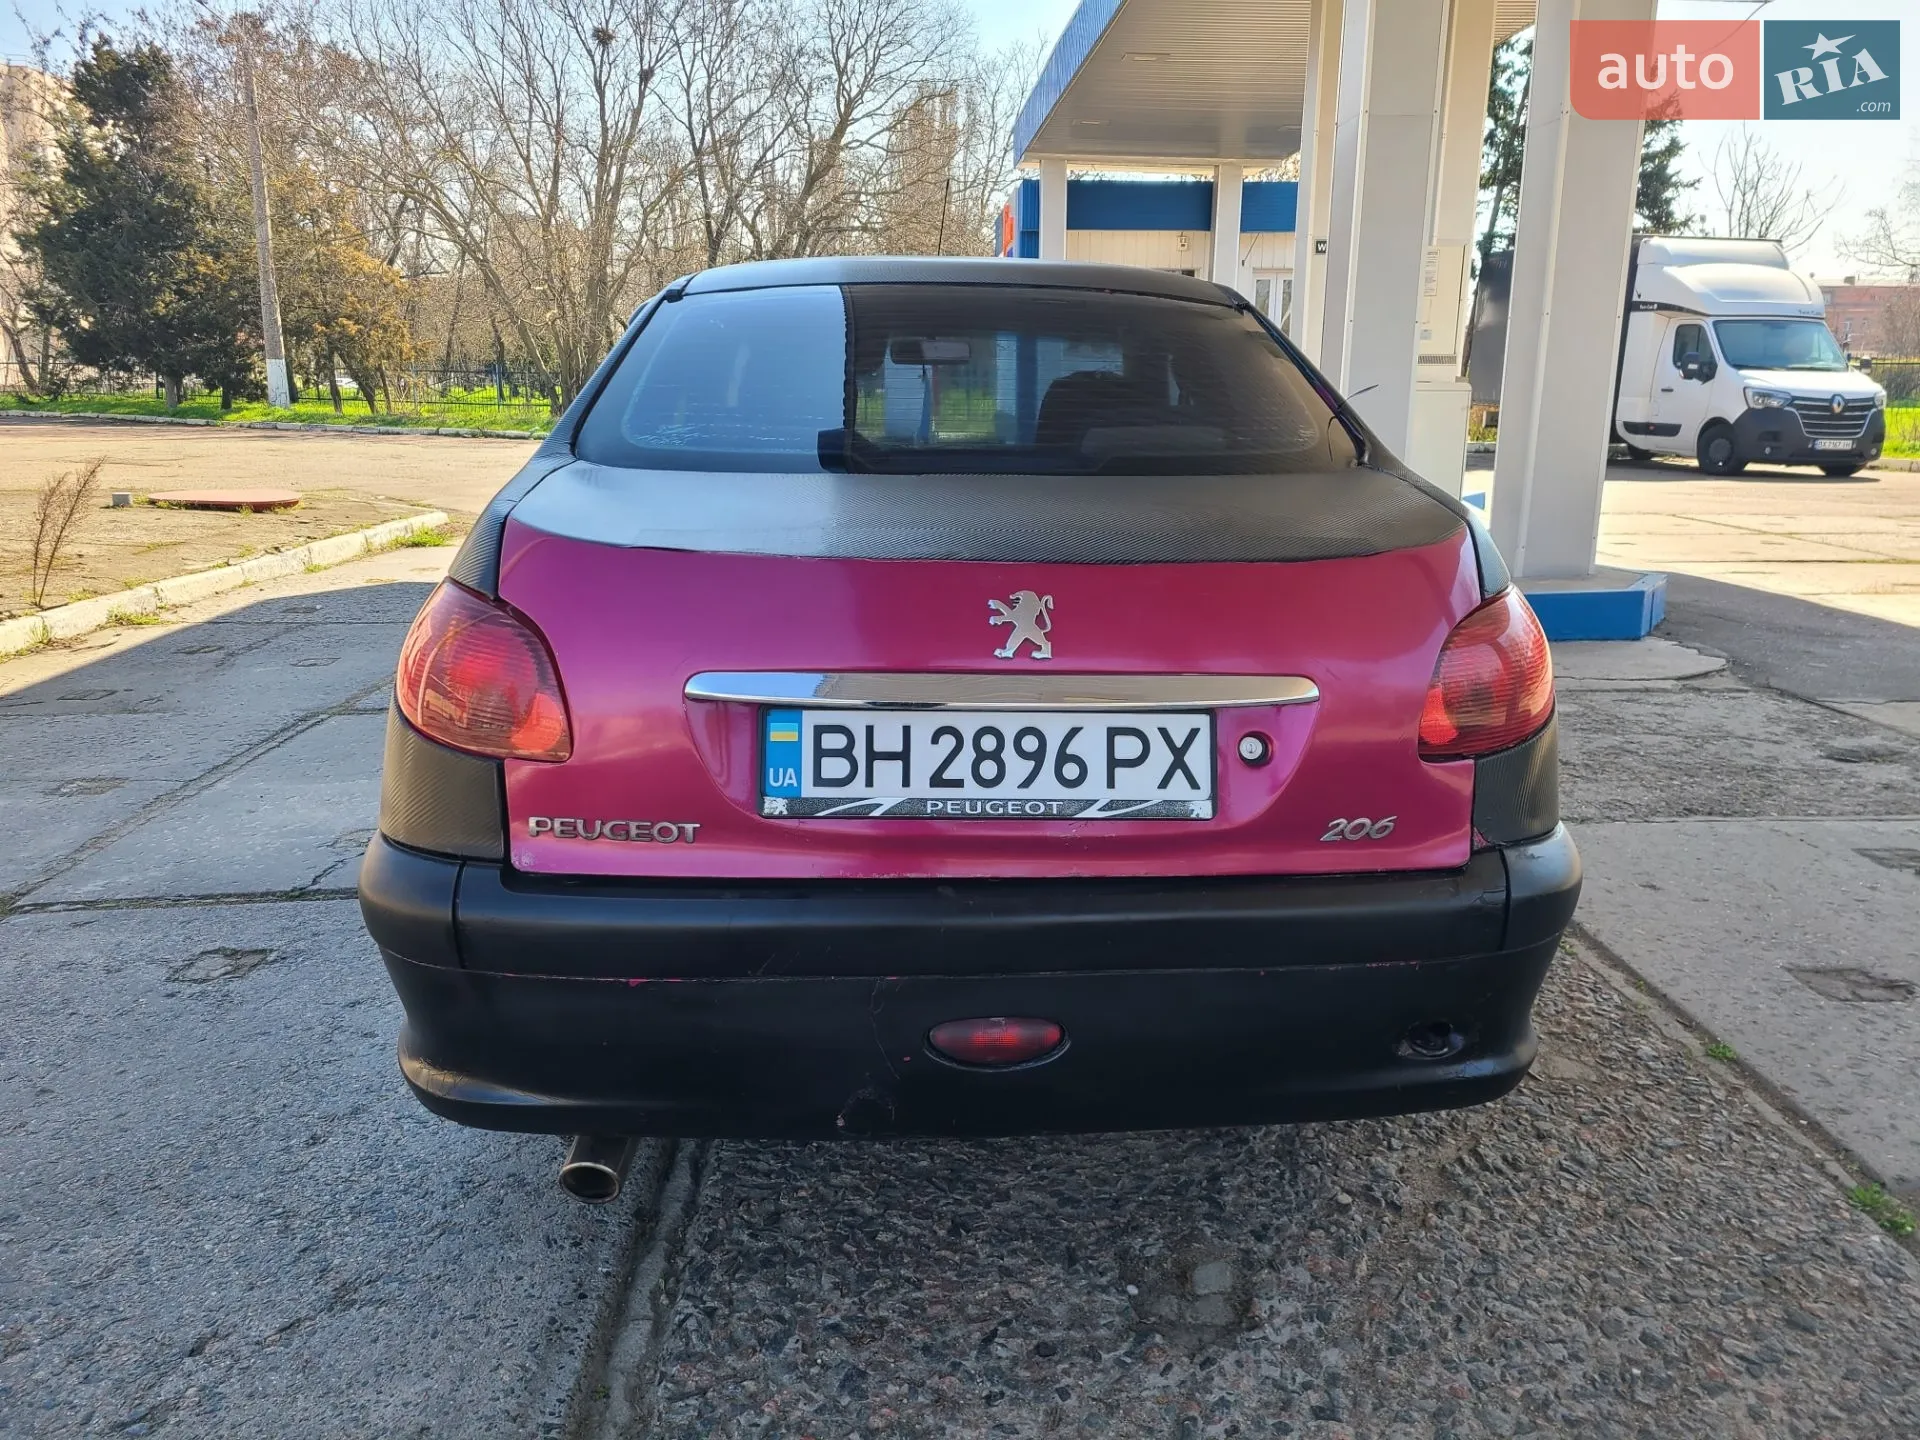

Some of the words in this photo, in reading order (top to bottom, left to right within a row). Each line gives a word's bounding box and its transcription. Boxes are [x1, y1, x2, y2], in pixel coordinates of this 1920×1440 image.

[812, 724, 911, 788] BH
[929, 725, 1089, 789] 2896
[1106, 726, 1202, 789] PX
[769, 767, 798, 787] UA
[926, 800, 1064, 815] PEUGEOT
[528, 816, 701, 844] PEUGEOT
[1319, 815, 1398, 842] 206
